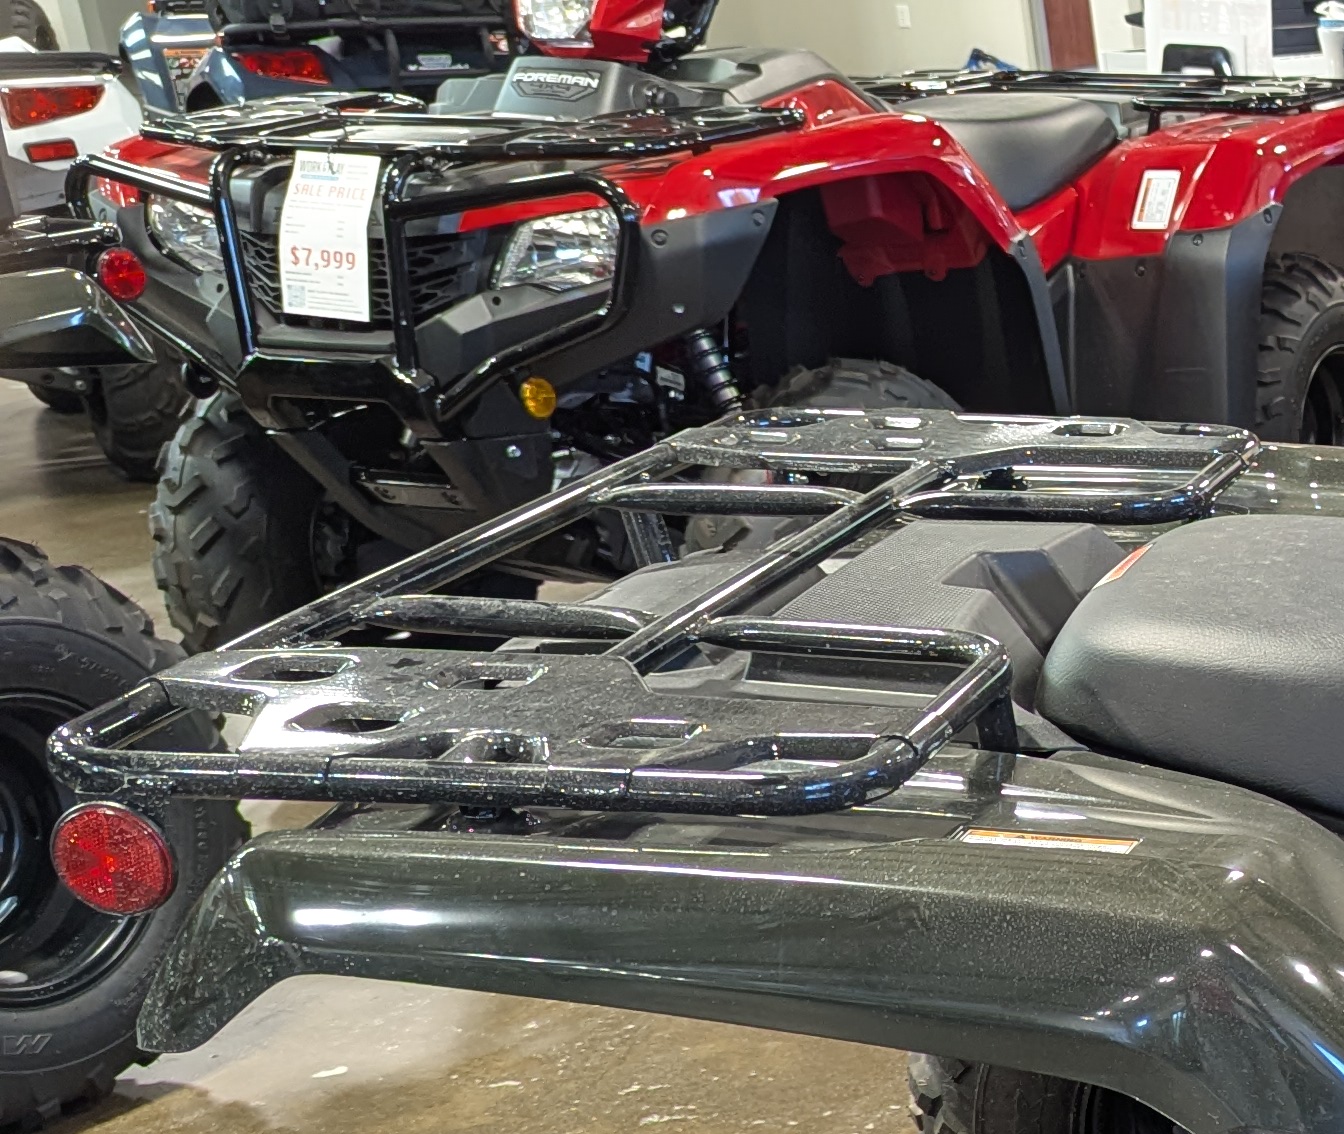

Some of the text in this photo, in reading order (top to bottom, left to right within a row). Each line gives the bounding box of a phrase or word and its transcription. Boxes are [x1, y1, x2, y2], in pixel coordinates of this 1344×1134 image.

[512, 72, 600, 89] FOREMAN
[293, 183, 368, 201] SALE PRICE
[290, 245, 356, 271] $7,999
